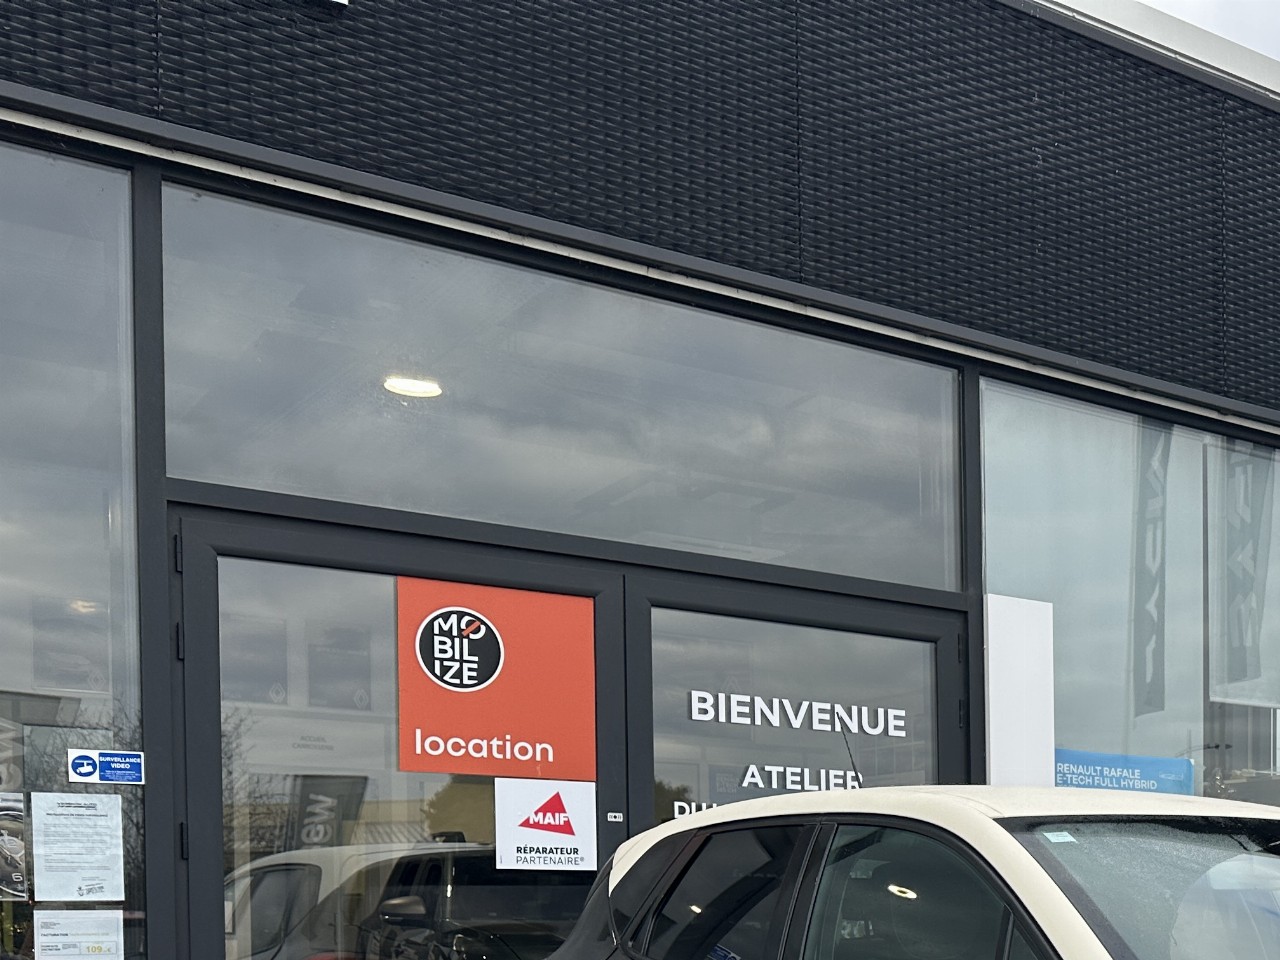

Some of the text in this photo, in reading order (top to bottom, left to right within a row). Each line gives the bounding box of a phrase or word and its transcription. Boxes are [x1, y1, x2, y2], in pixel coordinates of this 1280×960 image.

[691, 690, 907, 738] BIENVENUE
[415, 728, 554, 763] location
[99, 756, 141, 764] SURVEILLANCE
[1056, 763, 1141, 779] RENAULT RAFALE
[1056, 774, 1158, 790] E-TECH FULL HYBRID
[529, 812, 569, 826] MAIF
[516, 844, 579, 855] RÉPARATEUR
